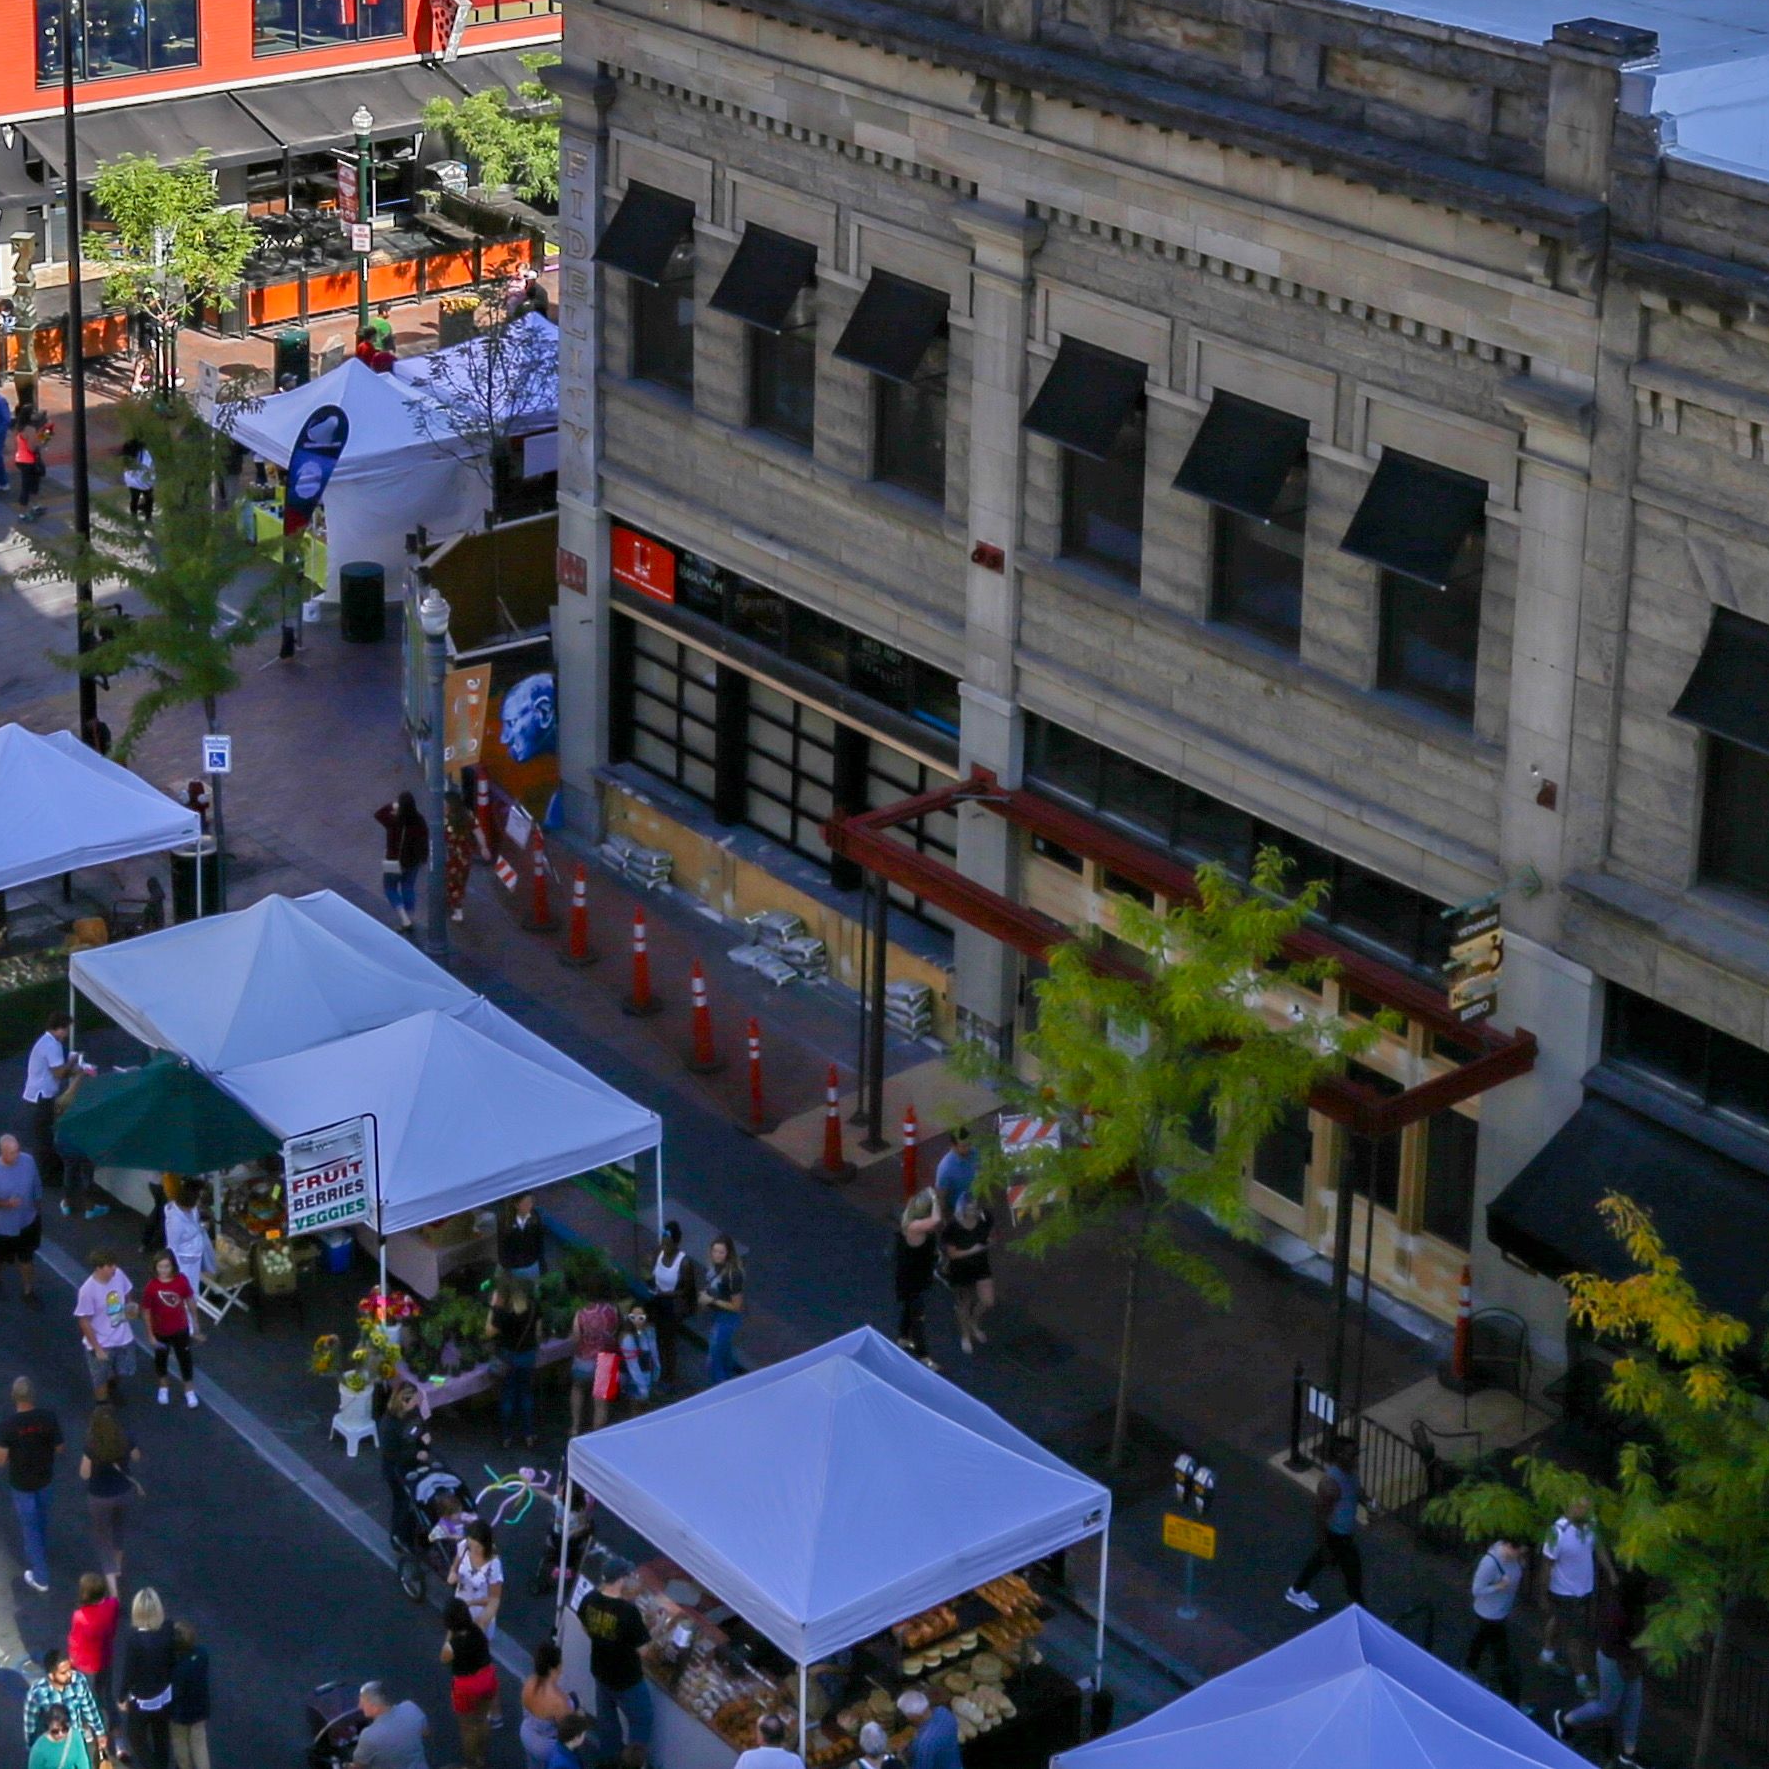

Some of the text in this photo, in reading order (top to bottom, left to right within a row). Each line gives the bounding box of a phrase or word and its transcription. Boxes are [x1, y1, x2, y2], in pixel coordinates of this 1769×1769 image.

[564, 145, 588, 444] FIDELITY
[291, 1159, 363, 1194] FRUIT
[293, 1178, 365, 1212] BERRIES
[294, 1197, 367, 1231] VEGGIES
